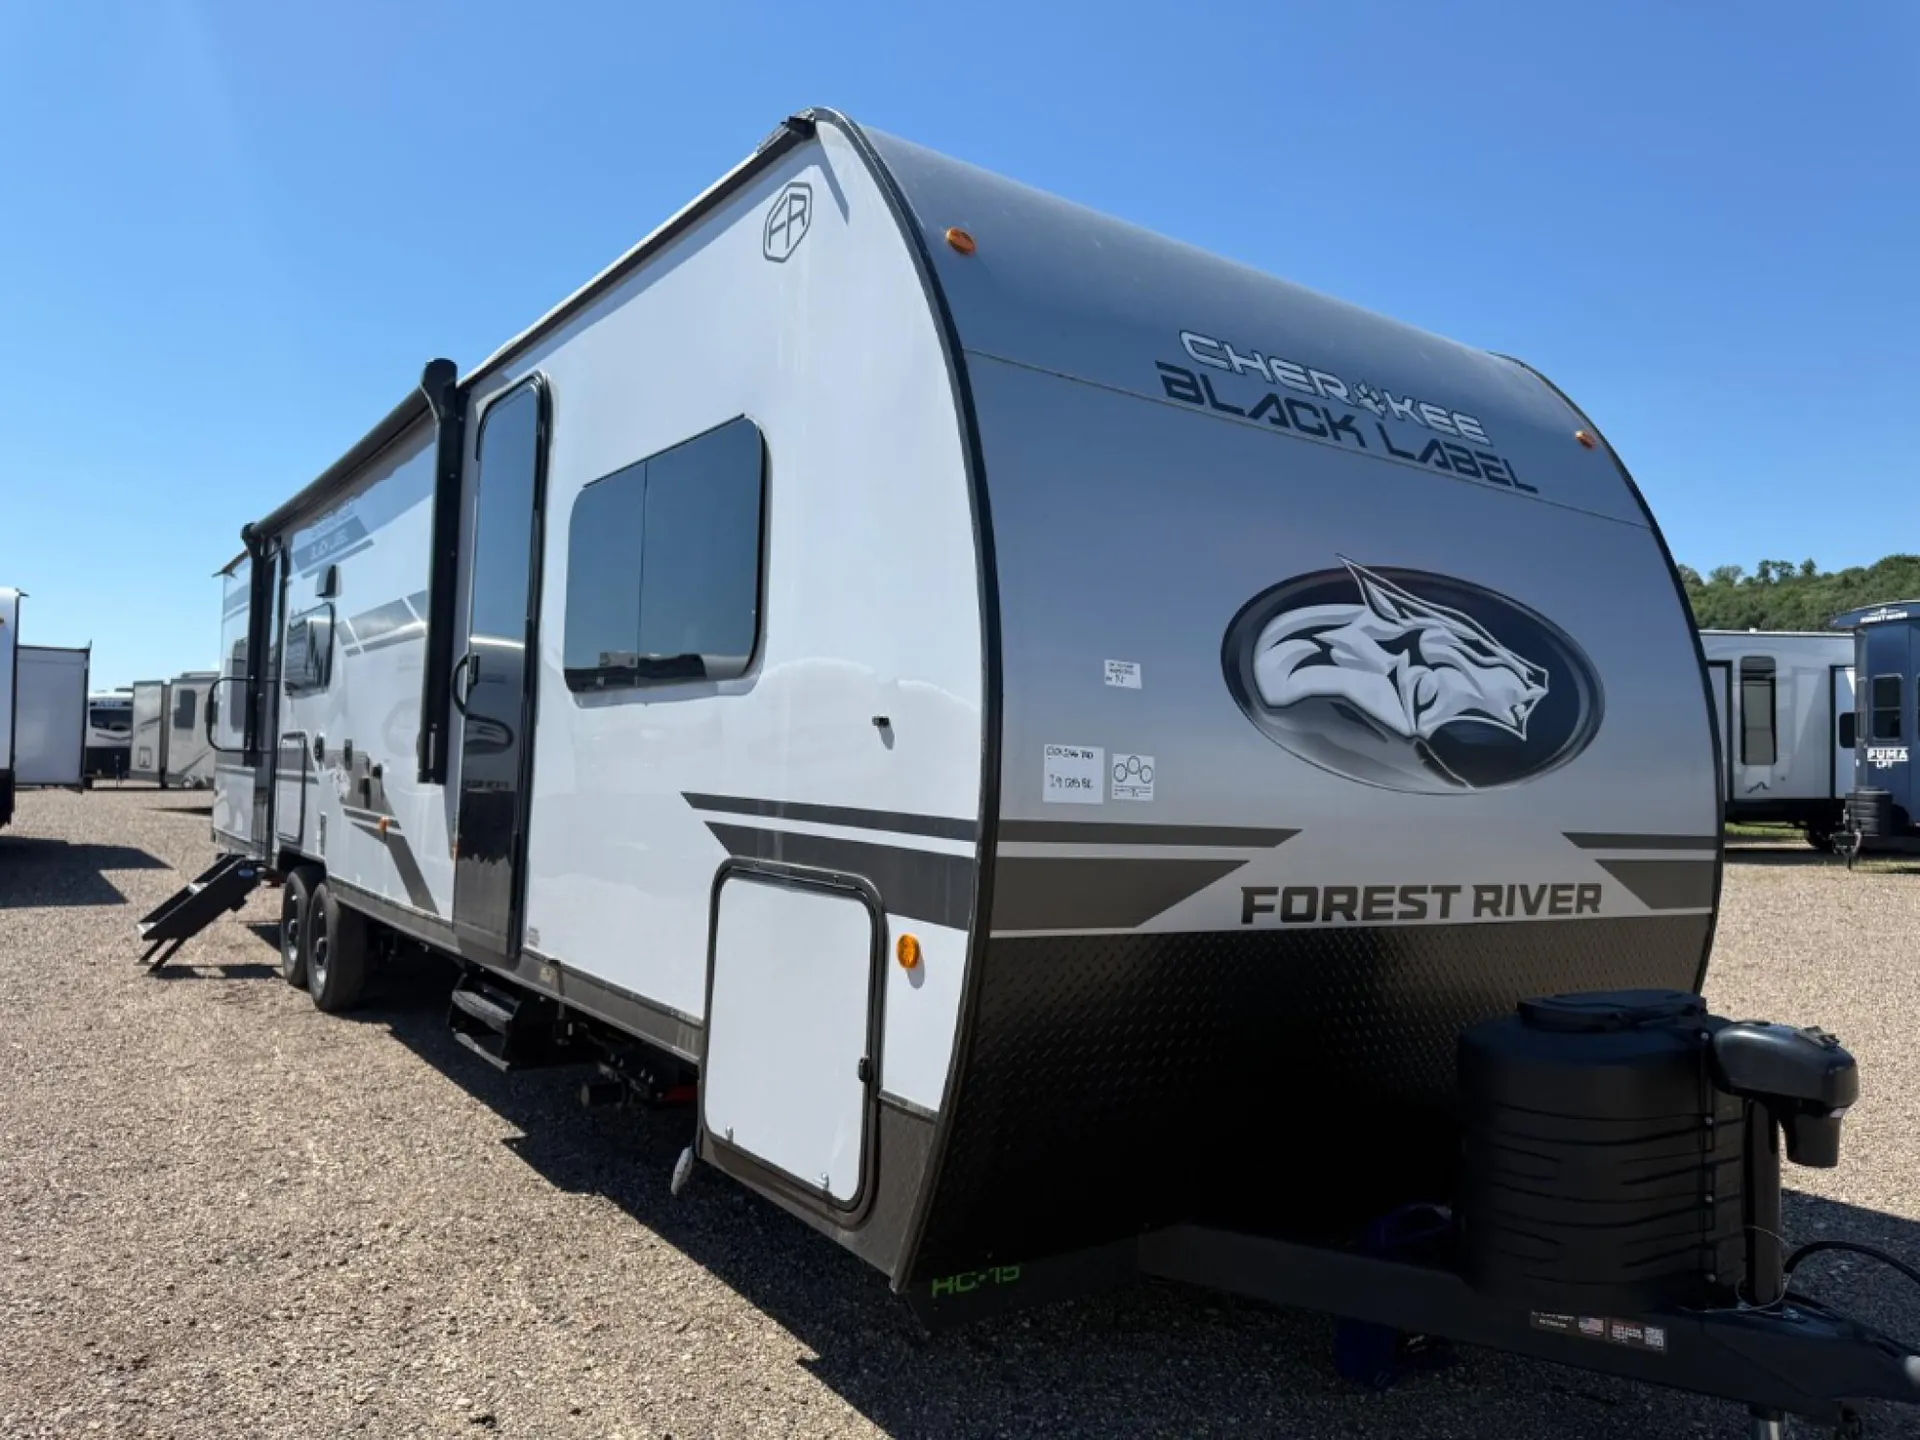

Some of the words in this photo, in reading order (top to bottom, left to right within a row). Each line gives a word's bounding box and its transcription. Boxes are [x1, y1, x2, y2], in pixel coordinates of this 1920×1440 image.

[1155, 360, 1367, 449] BLACK
[1376, 421, 1540, 494] LABEL
[1240, 884, 1462, 925] FOREST
[1472, 882, 1602, 918] RIVER
